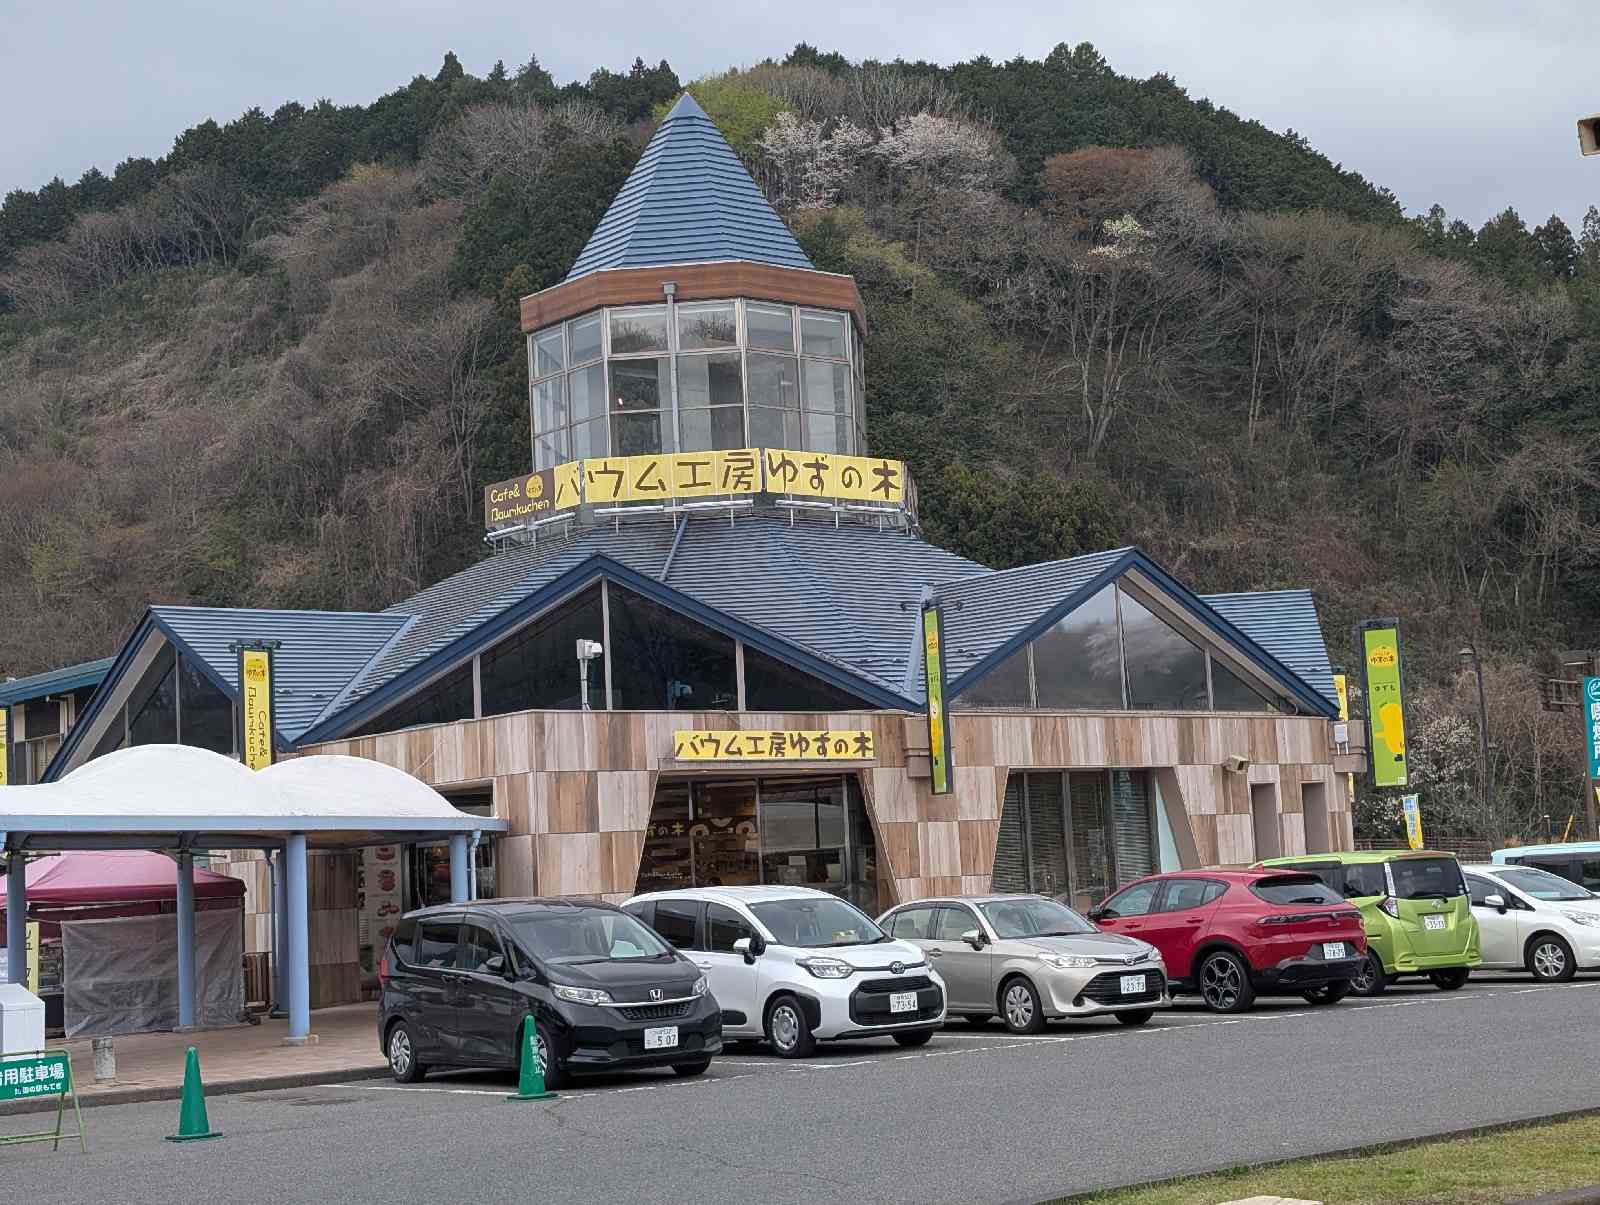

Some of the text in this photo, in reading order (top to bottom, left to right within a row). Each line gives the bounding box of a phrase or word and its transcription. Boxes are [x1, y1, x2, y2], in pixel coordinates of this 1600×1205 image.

[490, 499, 550, 521] Baumkuchen
[248, 687, 256, 770] Baumkuche
[675, 732, 874, 758] バウム工房ゆずの木
[0, 1063, 65, 1086] 用駐車場
